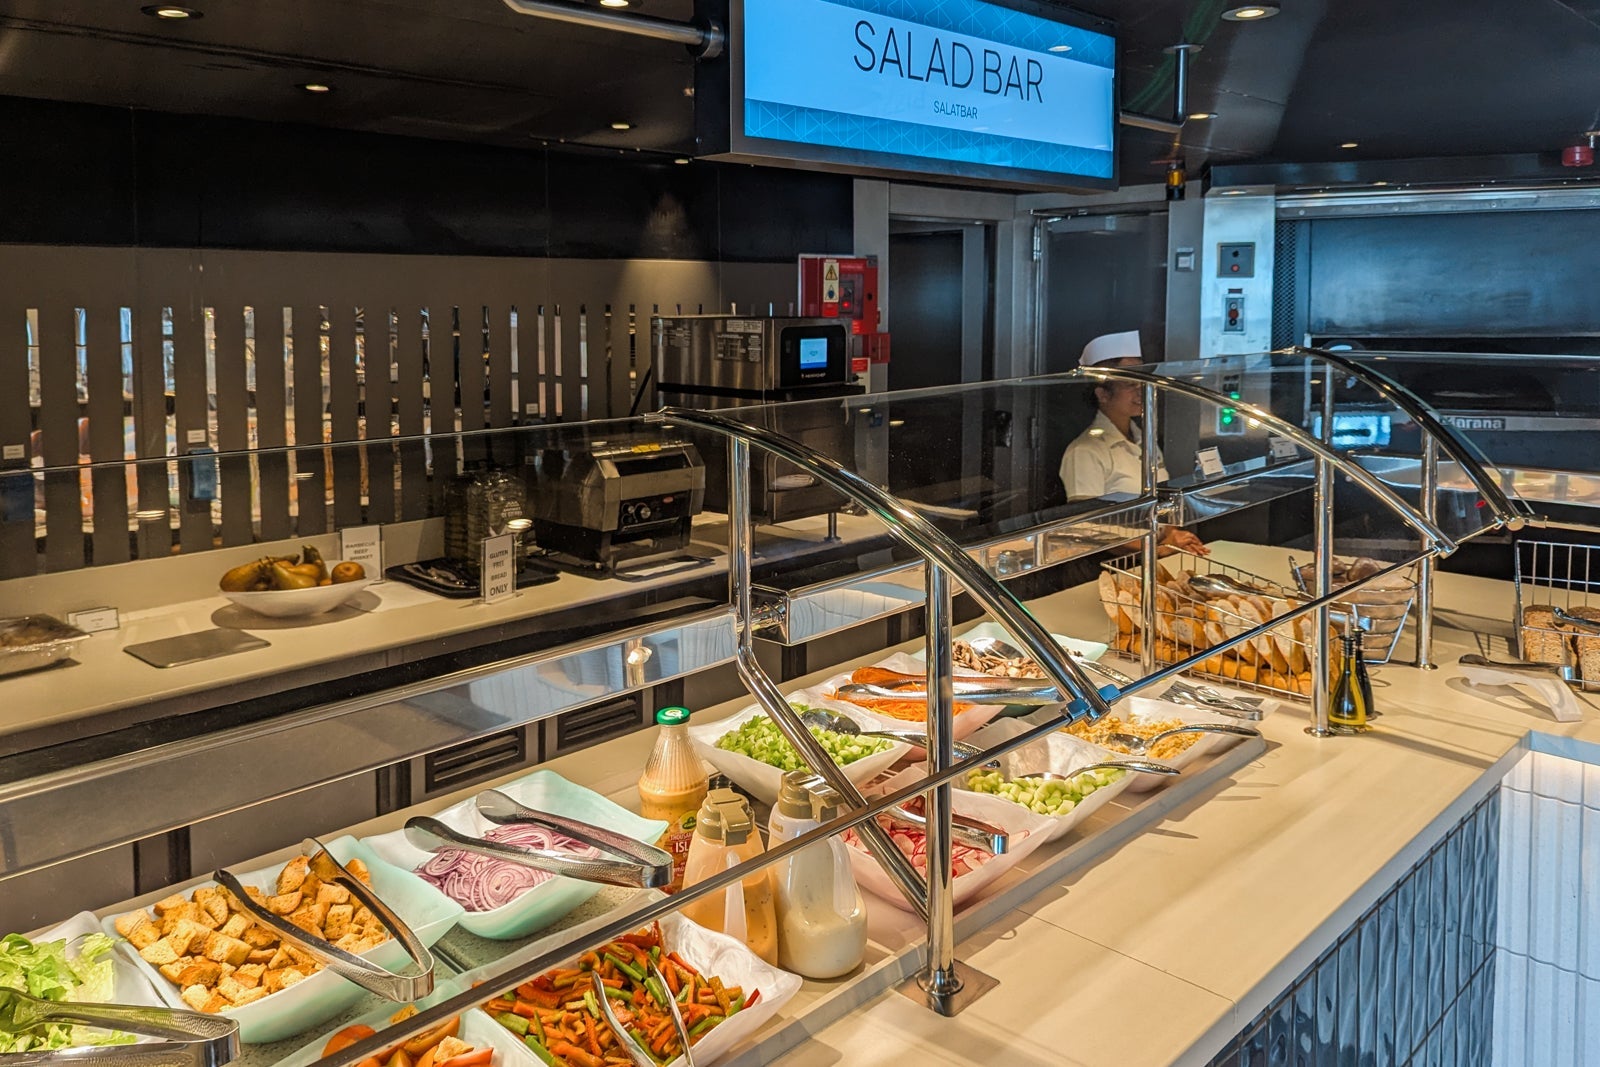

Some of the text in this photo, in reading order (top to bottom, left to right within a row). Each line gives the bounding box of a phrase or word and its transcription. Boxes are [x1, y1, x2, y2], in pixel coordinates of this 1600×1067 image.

[853, 20, 1043, 104] SALAD BAR
[933, 100, 978, 120] SALATBAR
[489, 549, 509, 560] GLUTEN
[489, 583, 509, 597] ONLY
[675, 841, 689, 853] ISL
